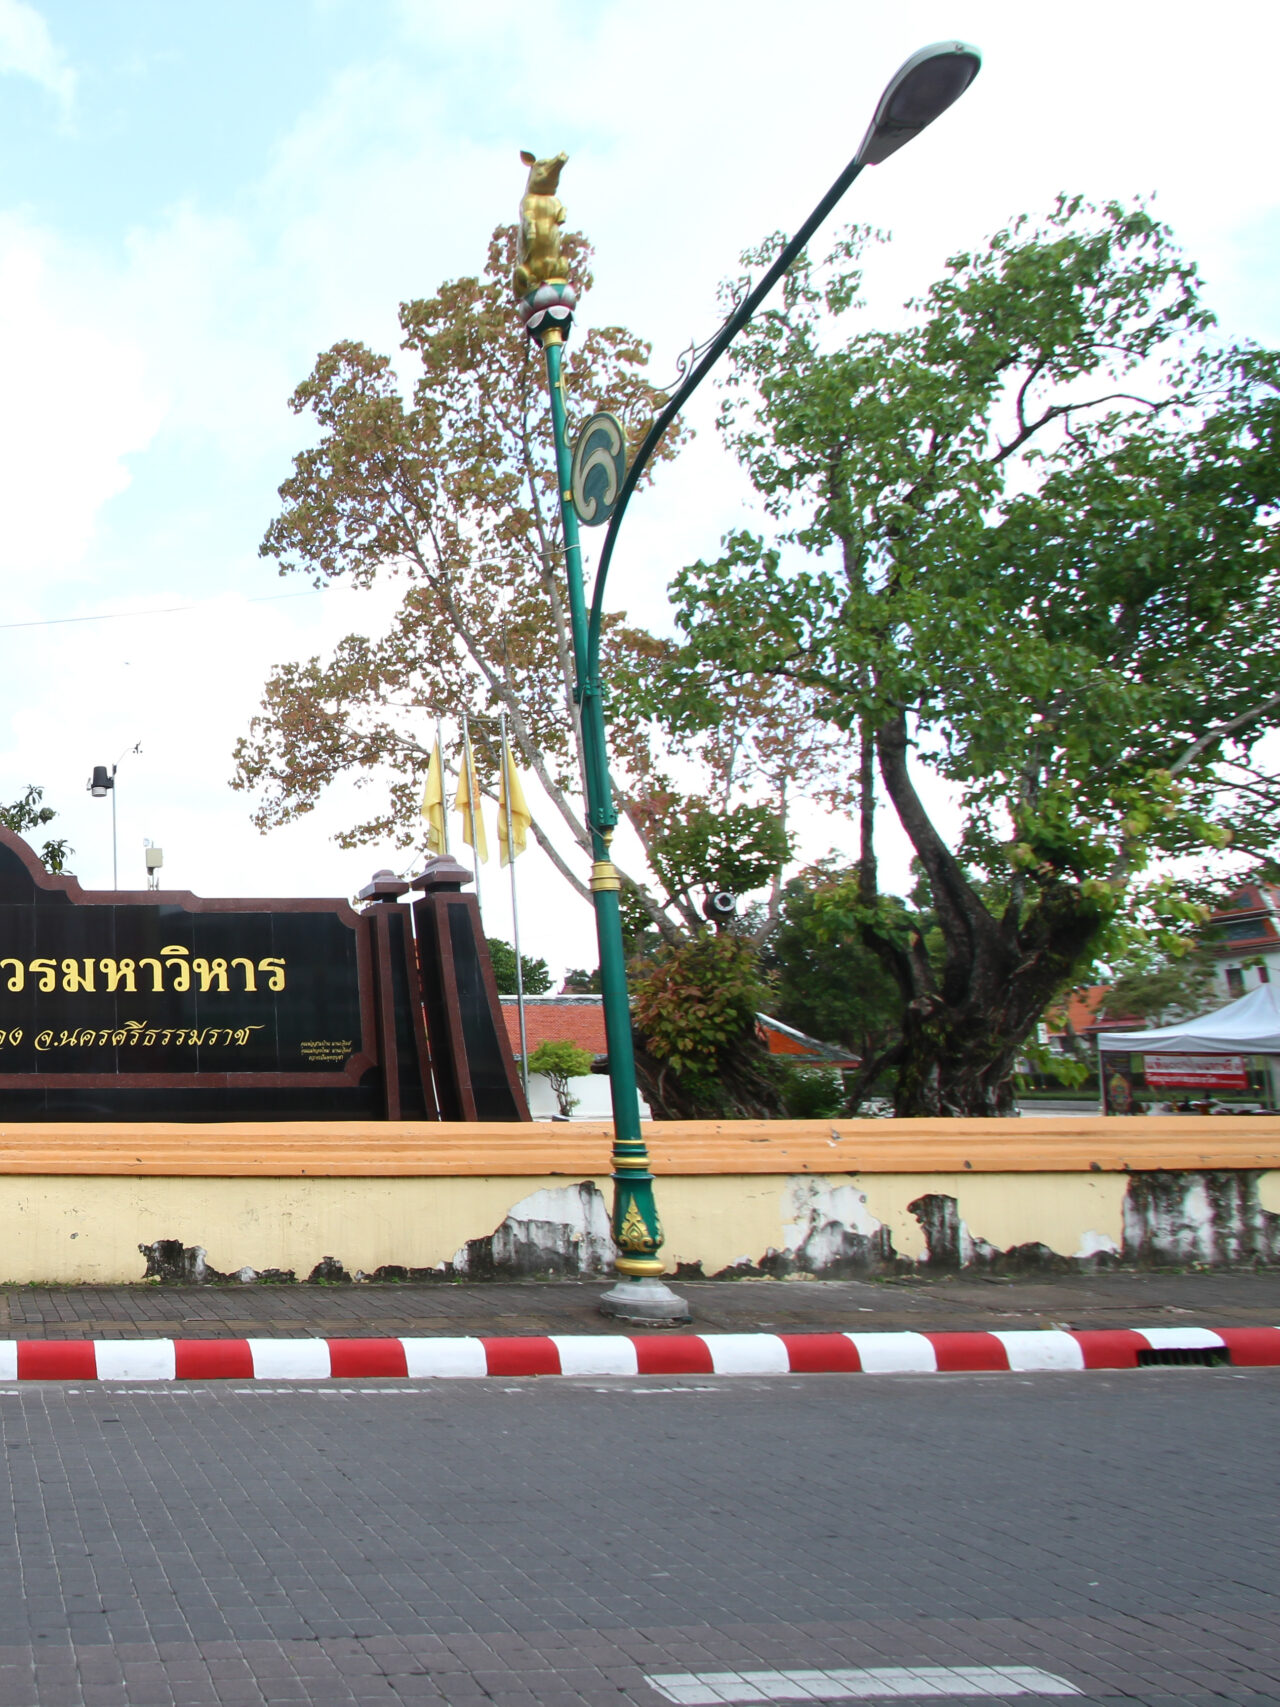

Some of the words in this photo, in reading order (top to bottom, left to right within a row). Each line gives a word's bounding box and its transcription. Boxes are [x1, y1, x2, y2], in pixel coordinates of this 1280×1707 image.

[0, 944, 286, 993] วรมหาวิหาร
[33, 1020, 265, 1051] จ.นครศรีธรรมราช
